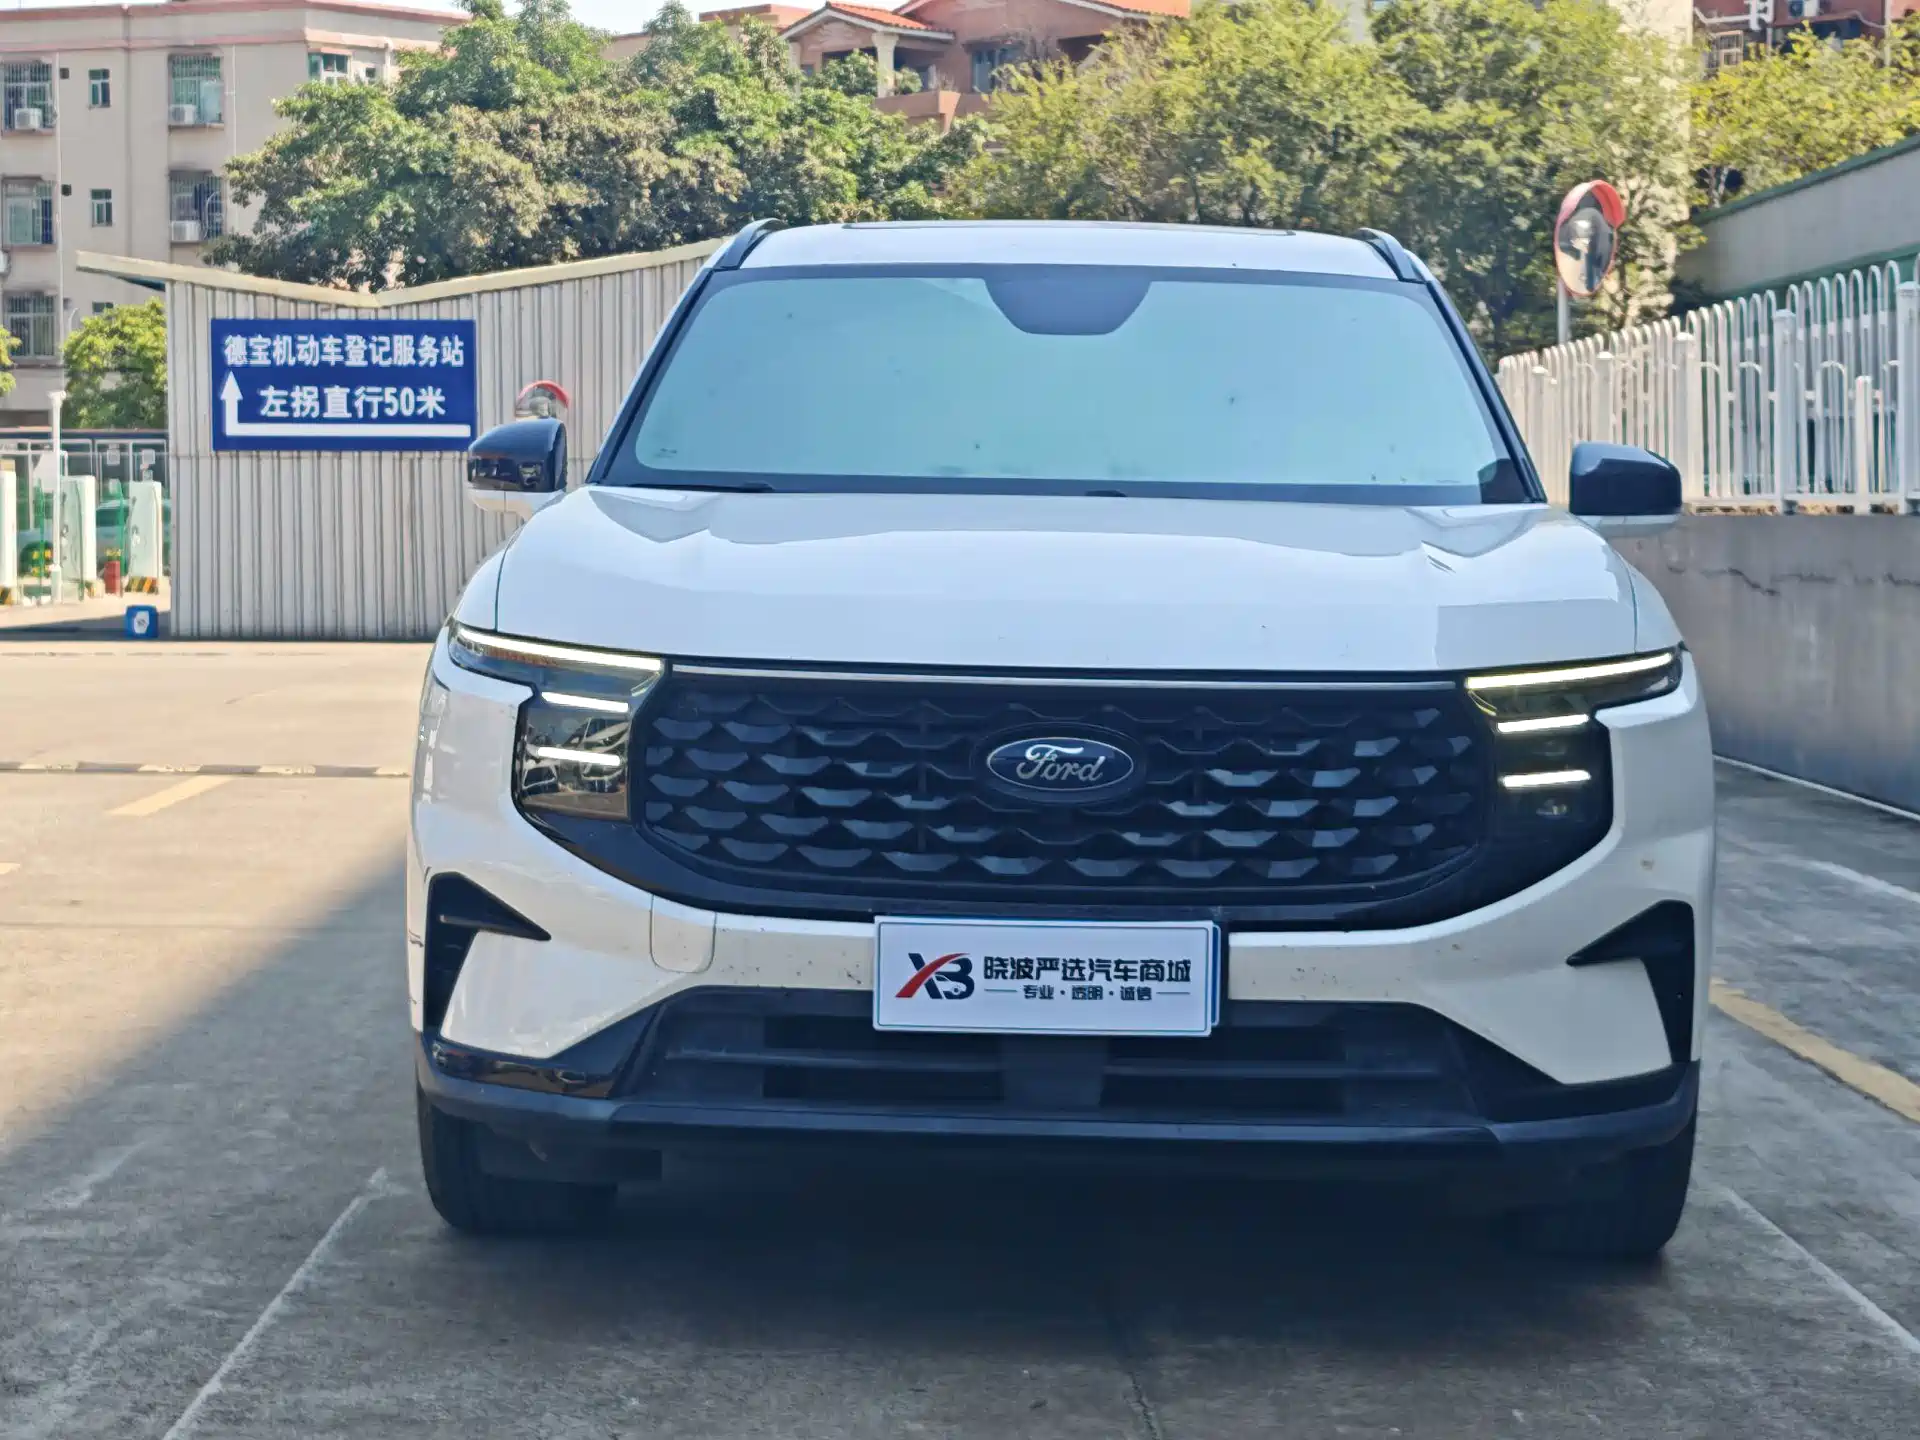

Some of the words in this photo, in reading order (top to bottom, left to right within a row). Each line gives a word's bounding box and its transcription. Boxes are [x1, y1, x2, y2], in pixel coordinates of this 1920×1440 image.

[224, 334, 465, 367] 德宝机动车登记服务站
[259, 385, 446, 419] 左拐直行50米
[1016, 744, 1106, 782] Ford
[983, 955, 1191, 983] 晓波严选汽车商城
